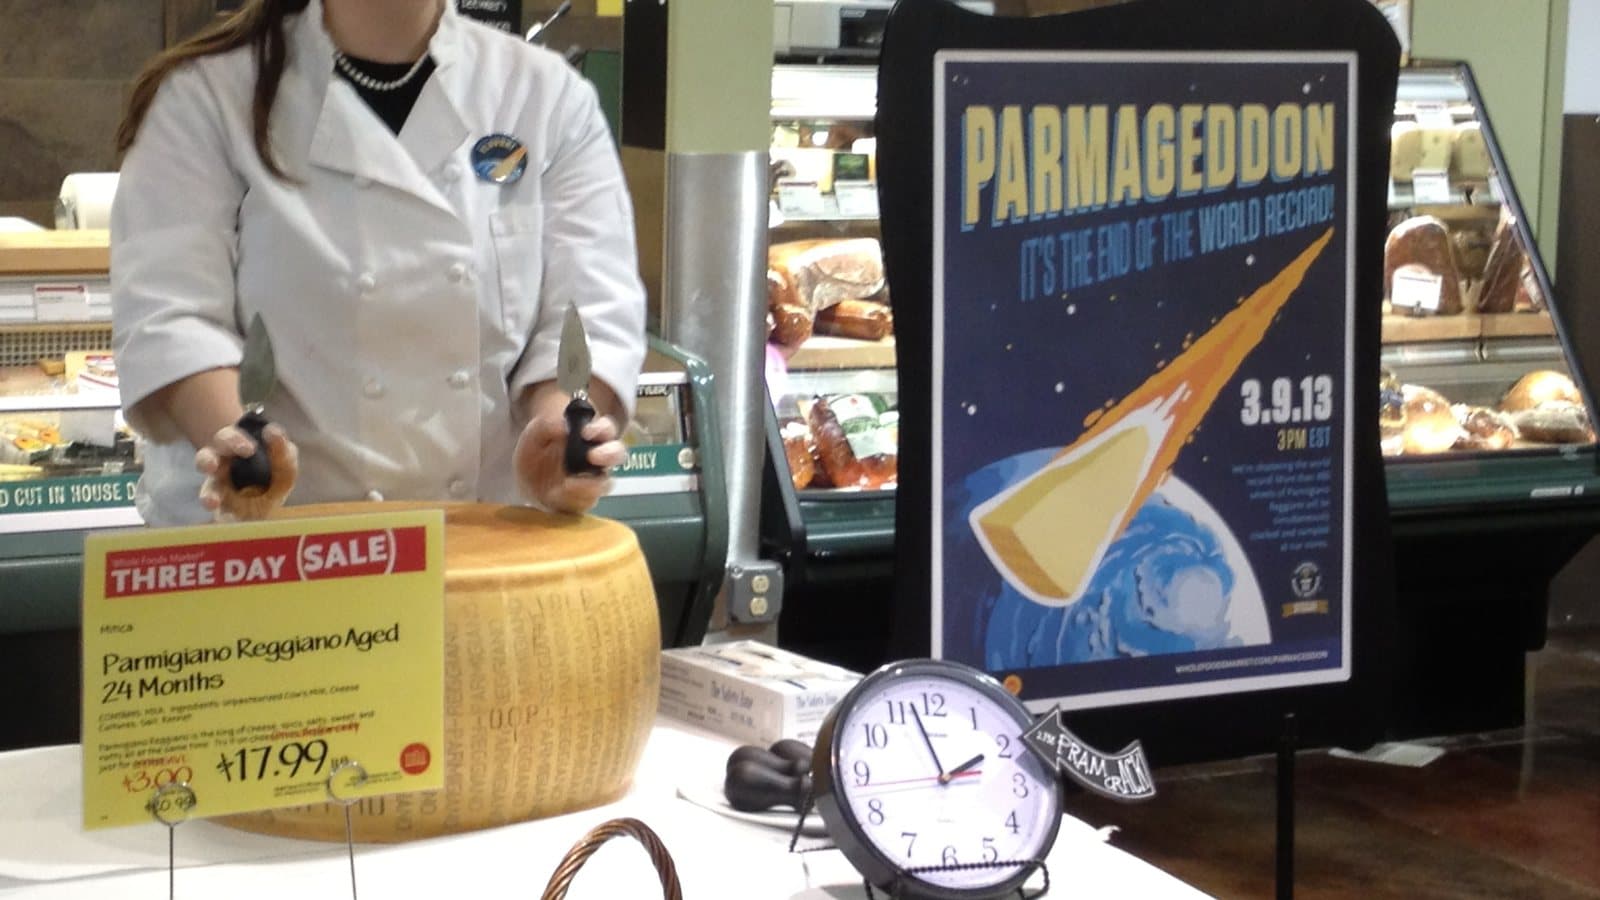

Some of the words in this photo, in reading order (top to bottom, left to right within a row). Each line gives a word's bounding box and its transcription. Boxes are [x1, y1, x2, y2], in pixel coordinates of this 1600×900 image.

[961, 102, 1334, 231] PARMAGEDDON
[1020, 235, 1054, 301] IT'S
[1060, 228, 1092, 290] THE
[1097, 221, 1131, 281] END
[1135, 215, 1158, 271] OF
[1163, 210, 1193, 263] THE
[1200, 198, 1258, 253] WORLD
[1264, 184, 1334, 237] RECORD!
[1240, 374, 1333, 426] 3.9.13
[1277, 428, 1306, 451] 3PM
[1309, 425, 1331, 448] EST
[623, 452, 657, 471] DAILY
[14, 487, 42, 506] CUT
[48, 485, 65, 504] IN
[71, 482, 122, 502] HOUSE
[111, 561, 215, 592] THREE
[224, 556, 286, 583] DAY
[103, 646, 232, 676] Parmigiano
[237, 634, 342, 662] Reggiano
[345, 622, 399, 652] Aged
[102, 680, 132, 704] 24
[139, 672, 224, 699] Months
[887, 701, 906, 724] 11
[921, 693, 947, 717] 12
[970, 707, 977, 730] 1
[864, 724, 888, 749] 10
[996, 734, 1012, 759] 2
[216, 739, 328, 782] $17.99
[854, 761, 870, 786] 9
[1013, 773, 1029, 799] 3
[868, 799, 884, 825] 8
[1005, 811, 1021, 834] 4
[901, 832, 917, 858] 7
[942, 846, 958, 870] 6
[982, 837, 998, 864] 5
